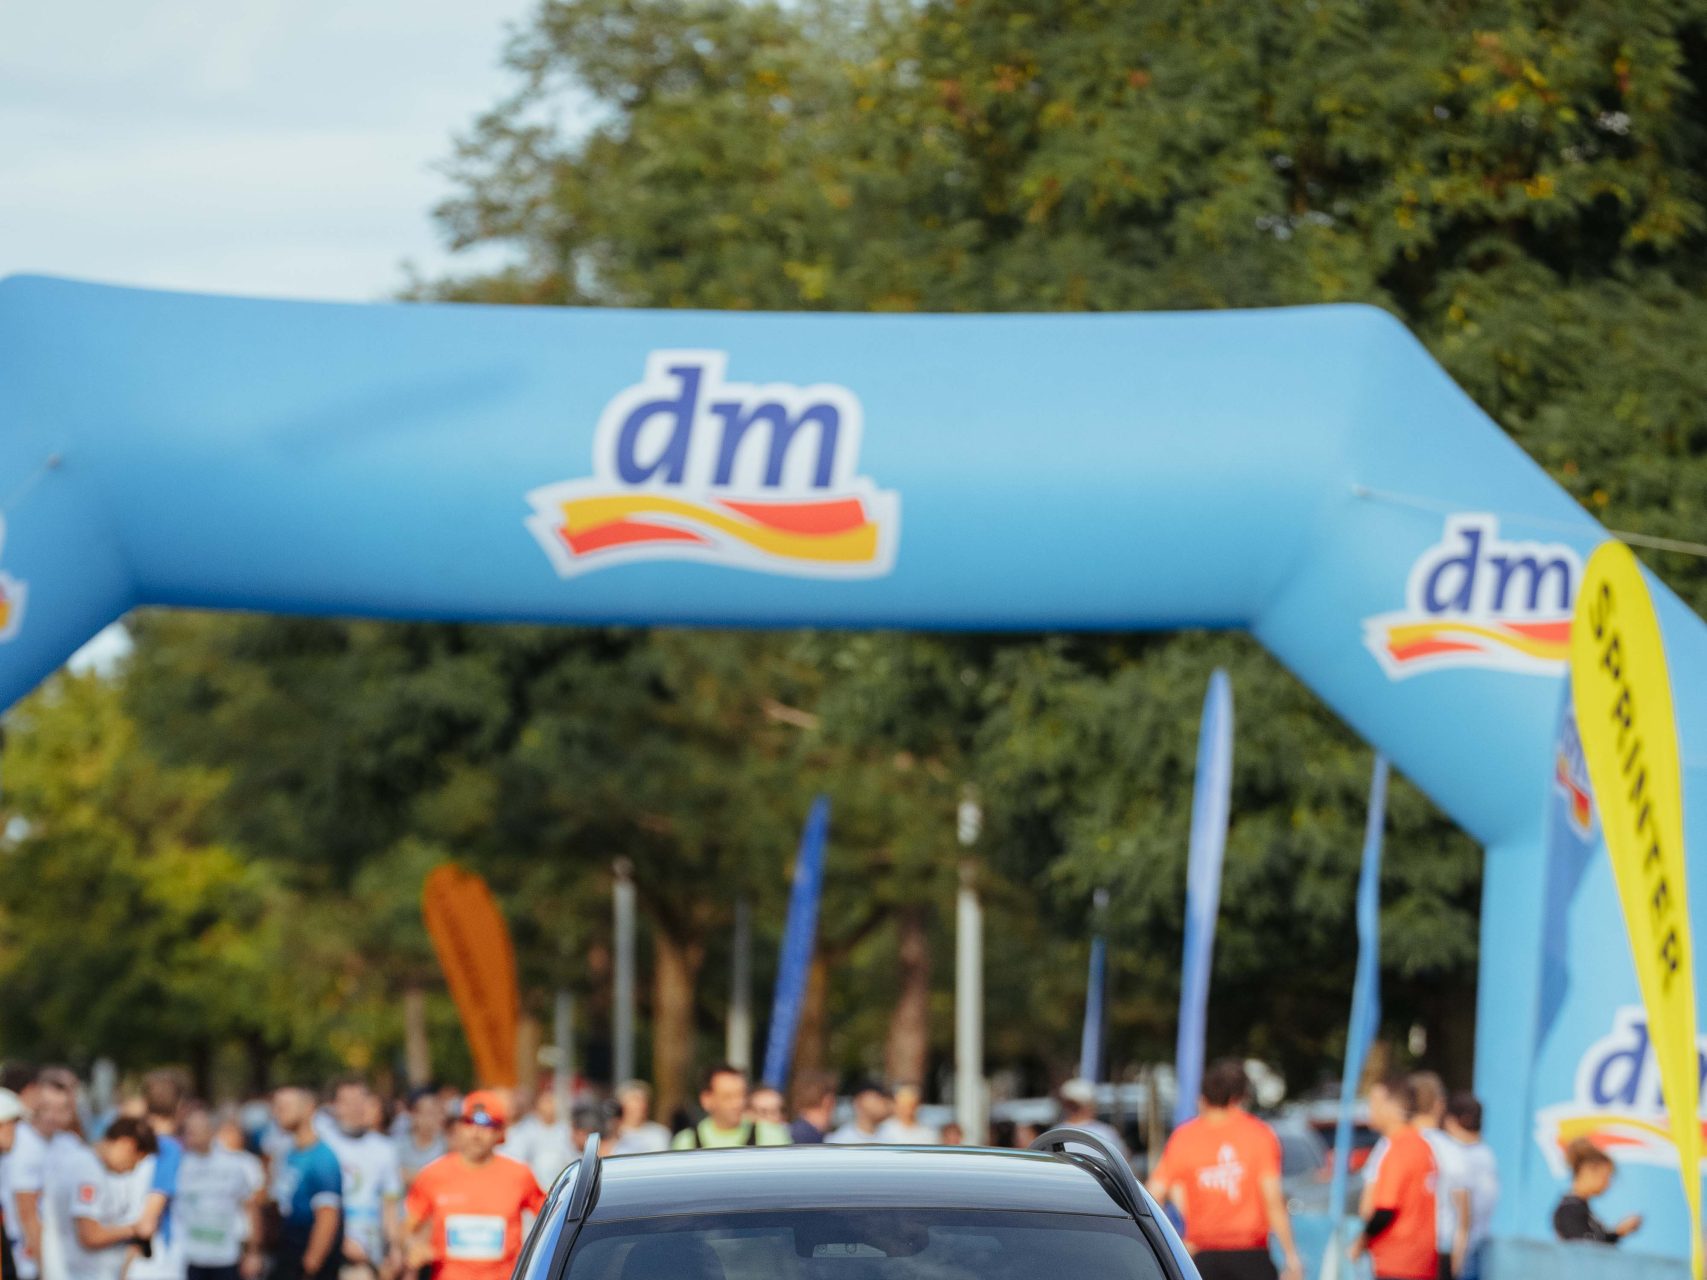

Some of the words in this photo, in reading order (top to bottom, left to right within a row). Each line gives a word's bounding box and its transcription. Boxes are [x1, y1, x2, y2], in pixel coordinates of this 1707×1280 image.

[616, 366, 840, 489] dm
[1422, 529, 1571, 614] dm
[1589, 580, 1683, 996] SPRINTER
